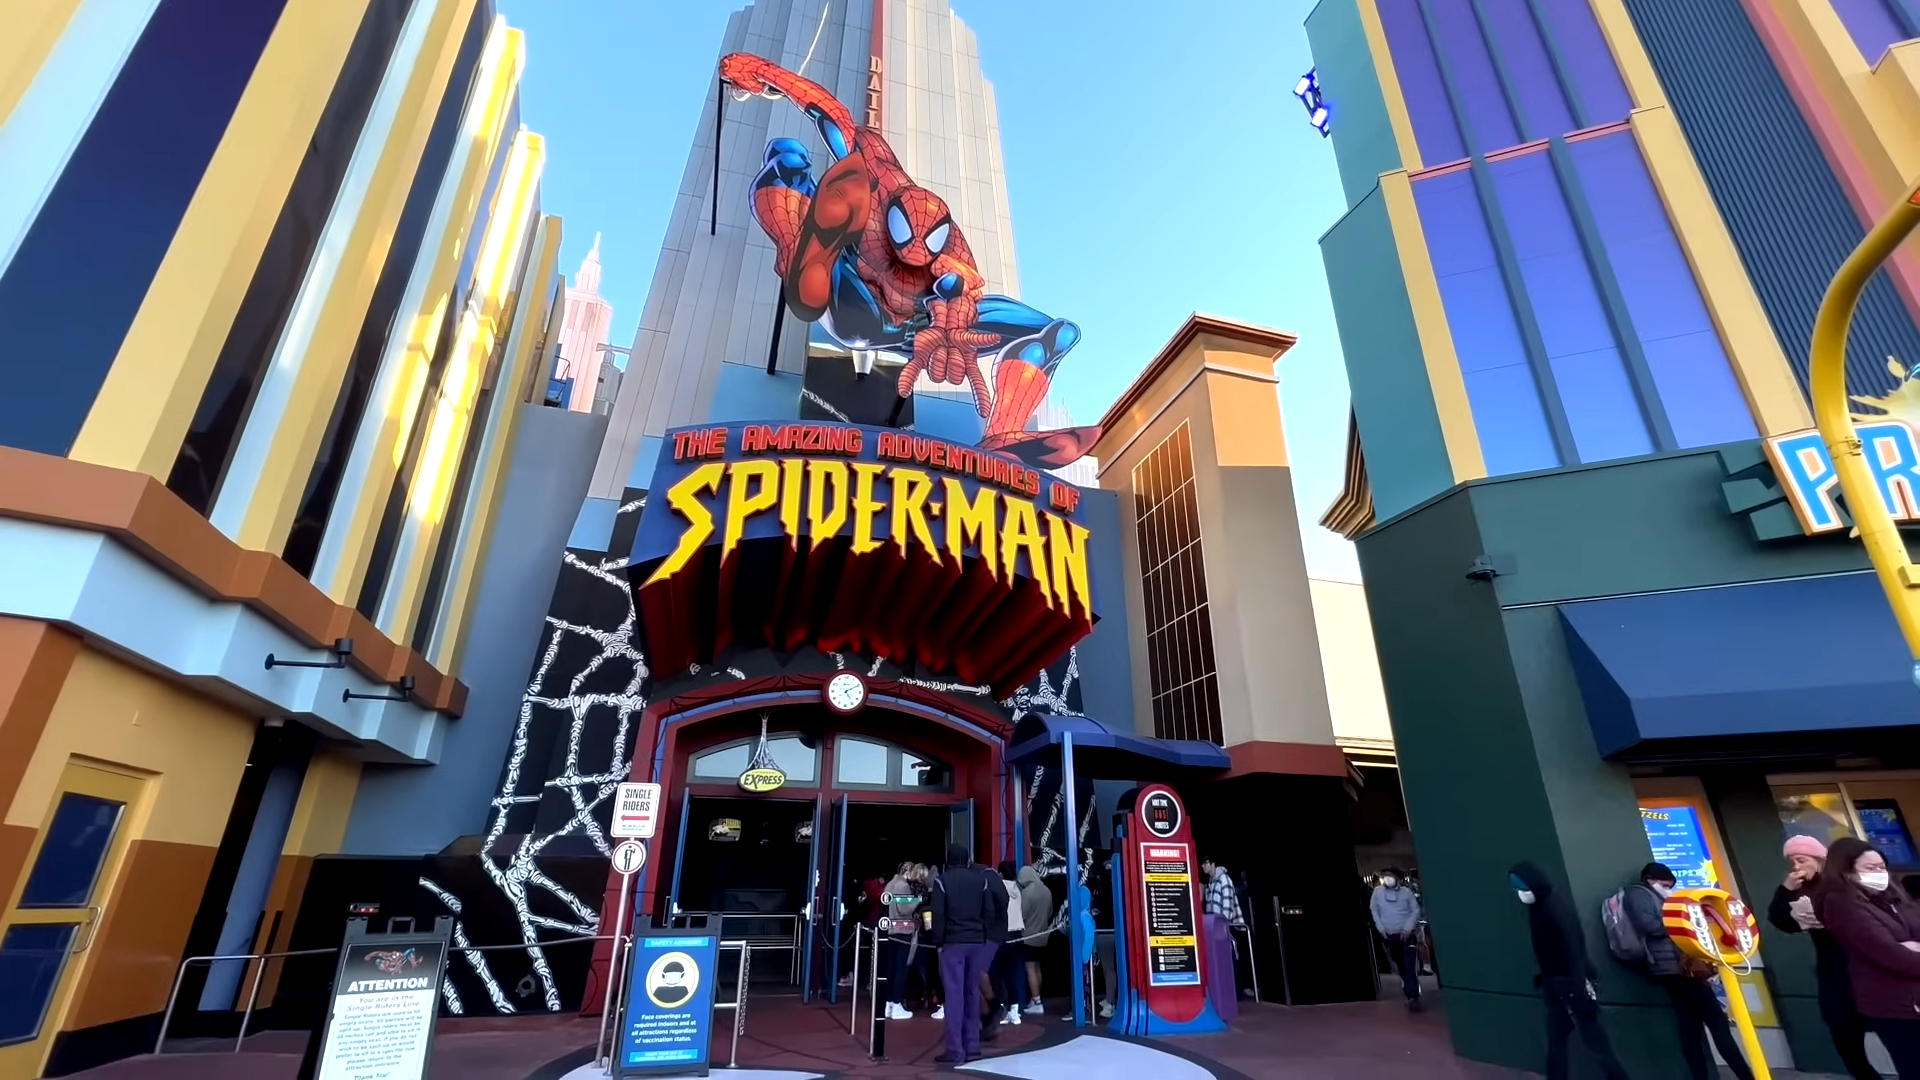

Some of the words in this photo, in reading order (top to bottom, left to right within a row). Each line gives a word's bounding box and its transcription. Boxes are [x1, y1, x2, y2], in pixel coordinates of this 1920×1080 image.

[673, 427, 728, 460] THE
[741, 424, 863, 454] AMAZING
[877, 432, 1041, 497] ADVENTURES
[1049, 480, 1080, 513] OF
[743, 774, 782, 790] EXPRESS
[624, 788, 652, 800] SINGLE
[622, 800, 651, 812] RIDERS
[347, 977, 429, 992] ATTENTION
[642, 1036, 673, 1044] vaccination
